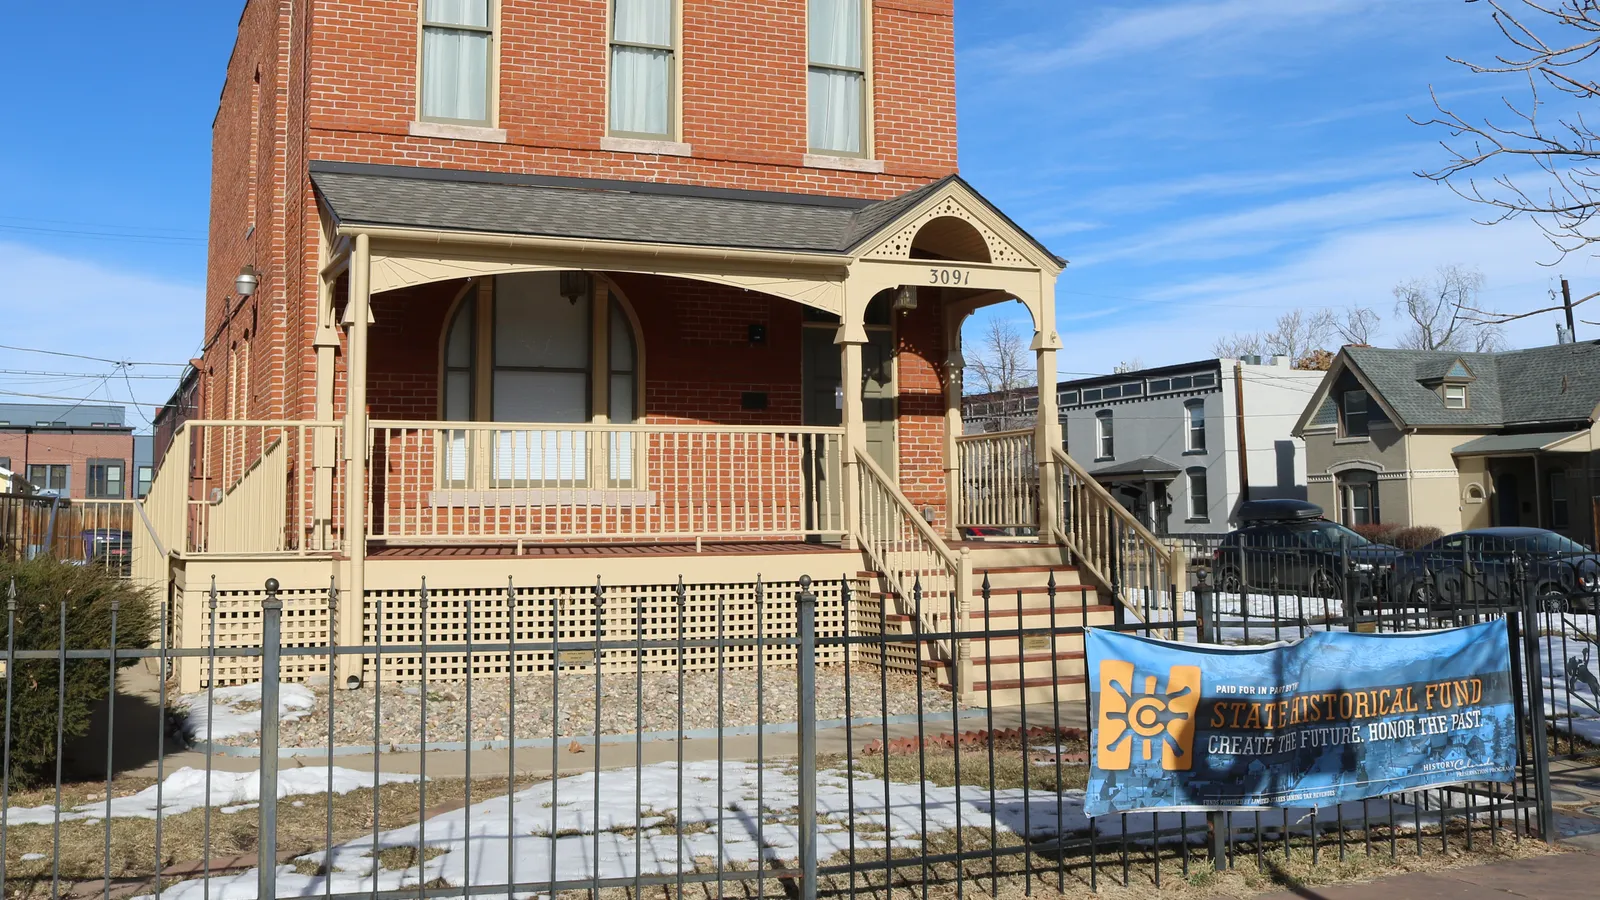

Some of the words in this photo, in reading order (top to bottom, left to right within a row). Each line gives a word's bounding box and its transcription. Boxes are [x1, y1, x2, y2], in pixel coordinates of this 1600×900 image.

[929, 269, 970, 285] 3091
[1216, 685, 1236, 694] PAID
[1239, 686, 1255, 694] FOR
[1258, 686, 1267, 695] IN
[1270, 685, 1285, 695] PART
[1210, 701, 1289, 730] STATE
[1289, 687, 1418, 725] HISTORICAL
[1425, 678, 1482, 710] FUND
[1208, 735, 1275, 755] CREATE
[1278, 731, 1297, 753] THE
[1300, 725, 1364, 749] FUTURE.
[1368, 719, 1416, 742] HONOR
[1418, 715, 1448, 736] THE
[1451, 710, 1483, 731] PAST.
[1423, 761, 1454, 772] HISTORY
